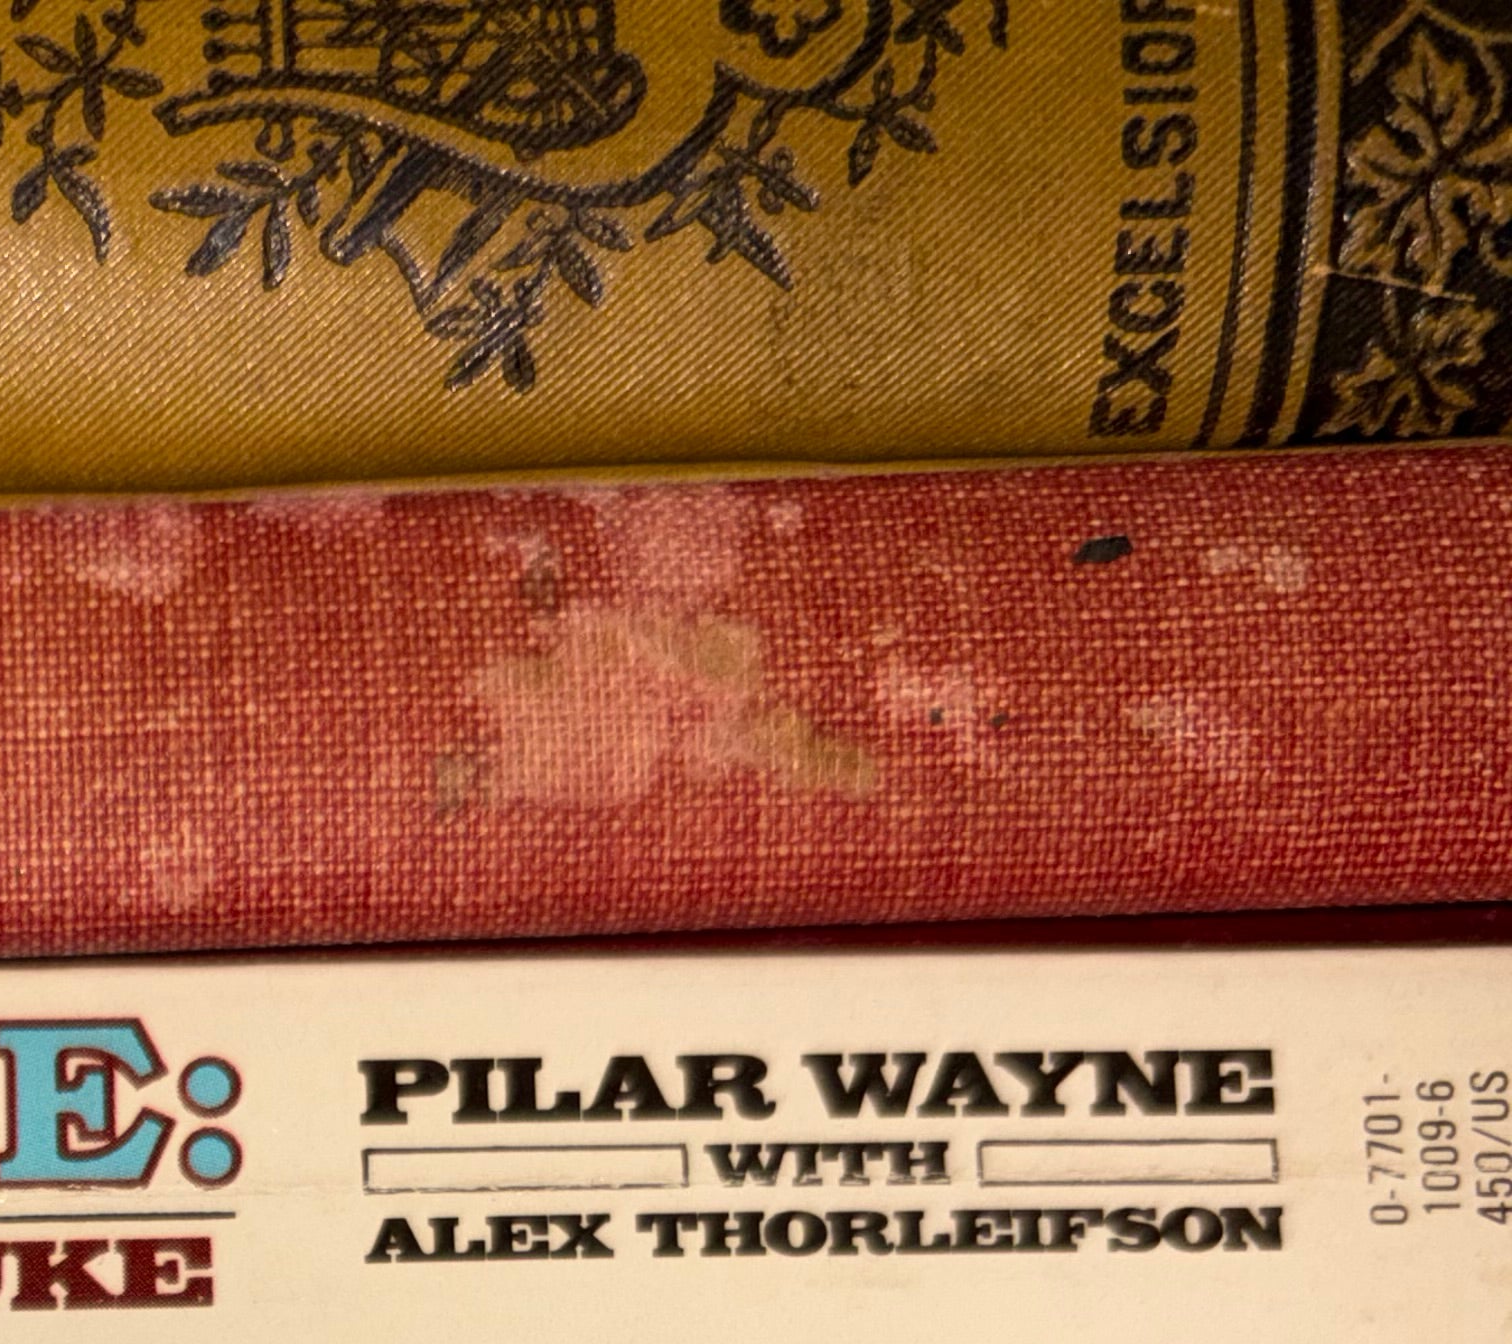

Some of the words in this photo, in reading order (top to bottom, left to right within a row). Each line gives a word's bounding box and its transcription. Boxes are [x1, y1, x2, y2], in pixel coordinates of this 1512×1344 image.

[357, 1053, 777, 1126] PILAR
[799, 1048, 1276, 1120] WAYNE
[704, 1140, 952, 1188] WITH
[1362, 1072, 1409, 1226] 0-7701-
[1415, 1079, 1462, 1215] 1009-6
[1469, 1070, 1512, 1225] 450/US
[363, 1212, 616, 1265] ALEX
[634, 1205, 1284, 1259] THORLEIFSON
